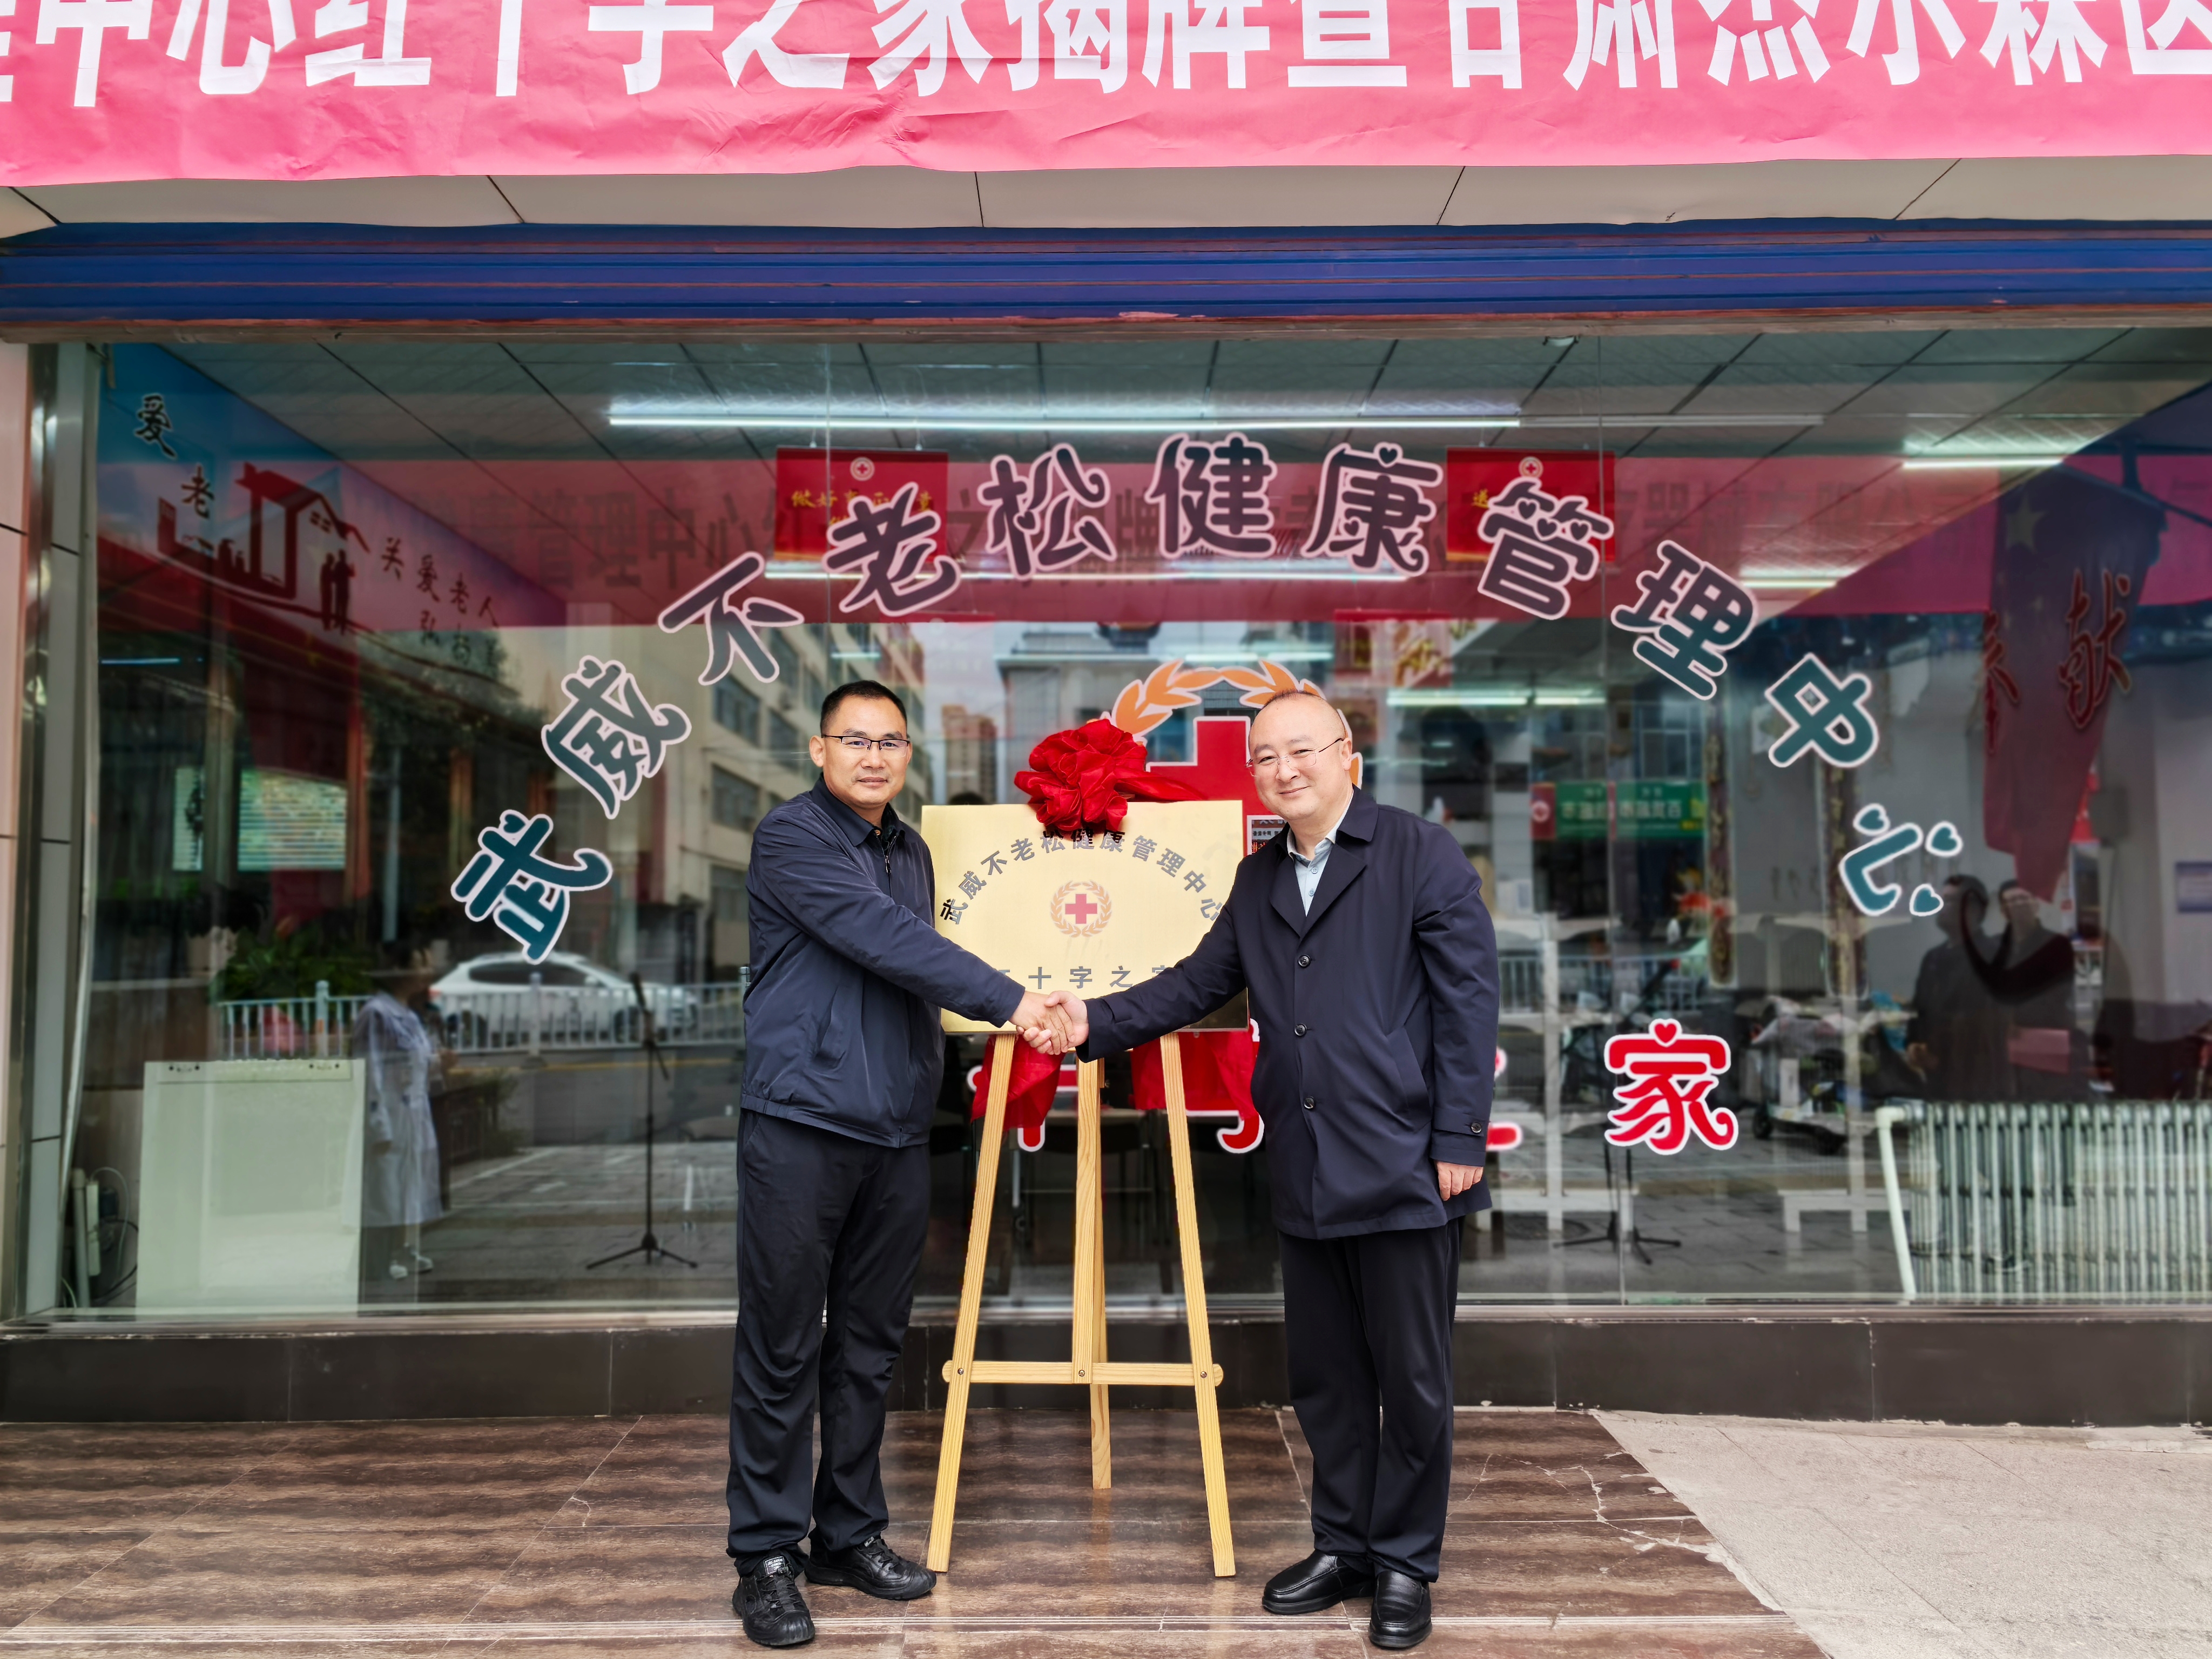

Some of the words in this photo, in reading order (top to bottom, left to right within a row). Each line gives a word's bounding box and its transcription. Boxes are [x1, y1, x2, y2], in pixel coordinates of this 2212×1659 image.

[451, 431, 1963, 965] 武威不老松健康管理中心
[940, 827, 1224, 925] 武威不老松健康管理中心
